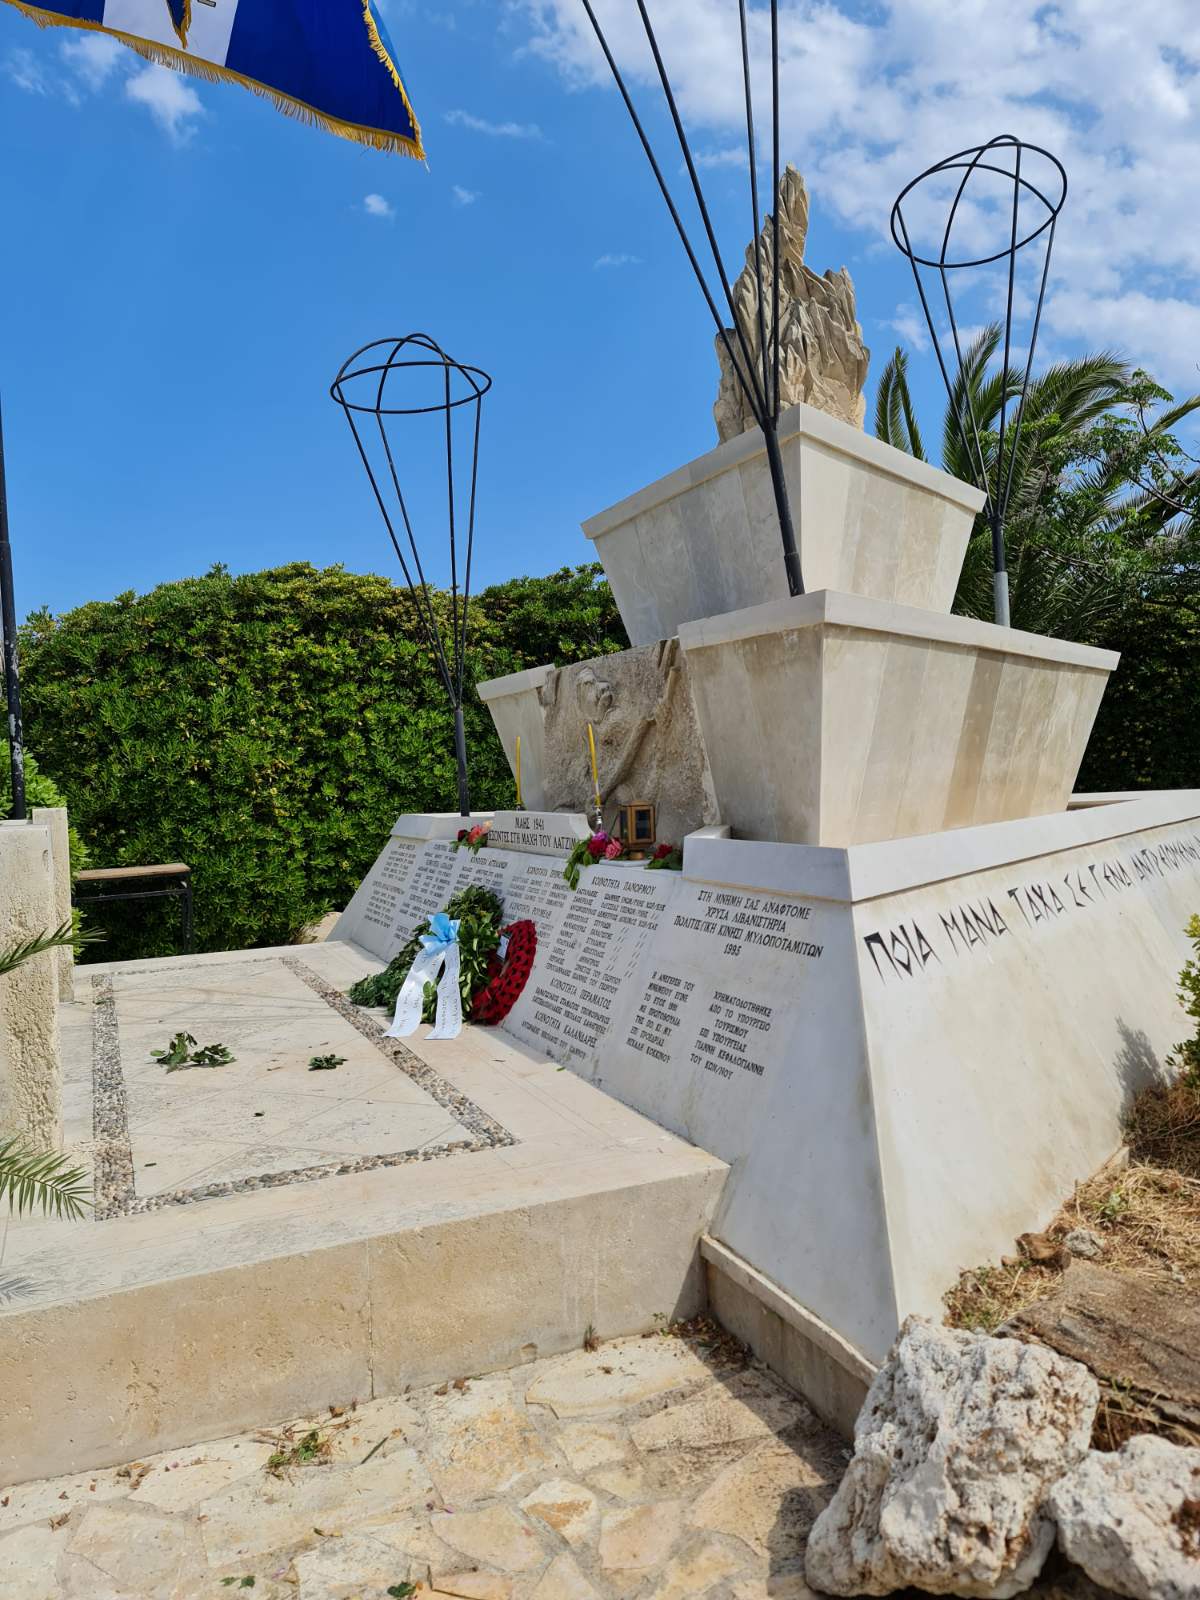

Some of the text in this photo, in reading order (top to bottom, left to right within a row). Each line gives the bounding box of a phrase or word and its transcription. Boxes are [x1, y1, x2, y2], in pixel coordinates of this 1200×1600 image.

[539, 834, 552, 847] ΤΟΥ
[698, 890, 713, 903] ΣΤΗ
[714, 893, 743, 907] ΜΝΗΜΗ
[744, 898, 761, 911] ΣΑΣ
[705, 906, 729, 921] ΧΡΥΣΑ
[863, 918, 943, 986] ΠΟΙΑ
[938, 896, 1012, 957] ΜΑΝΑ
[1007, 881, 1068, 929] ΤΑΧΑ
[724, 943, 742, 956] 1995
[744, 930, 824, 958] ΜΥΛΟΠΟΤΑΜΙΤΩΝ
[724, 1009, 734, 1019] ΤΟ
[690, 1053, 702, 1065] ΤΟΥ
